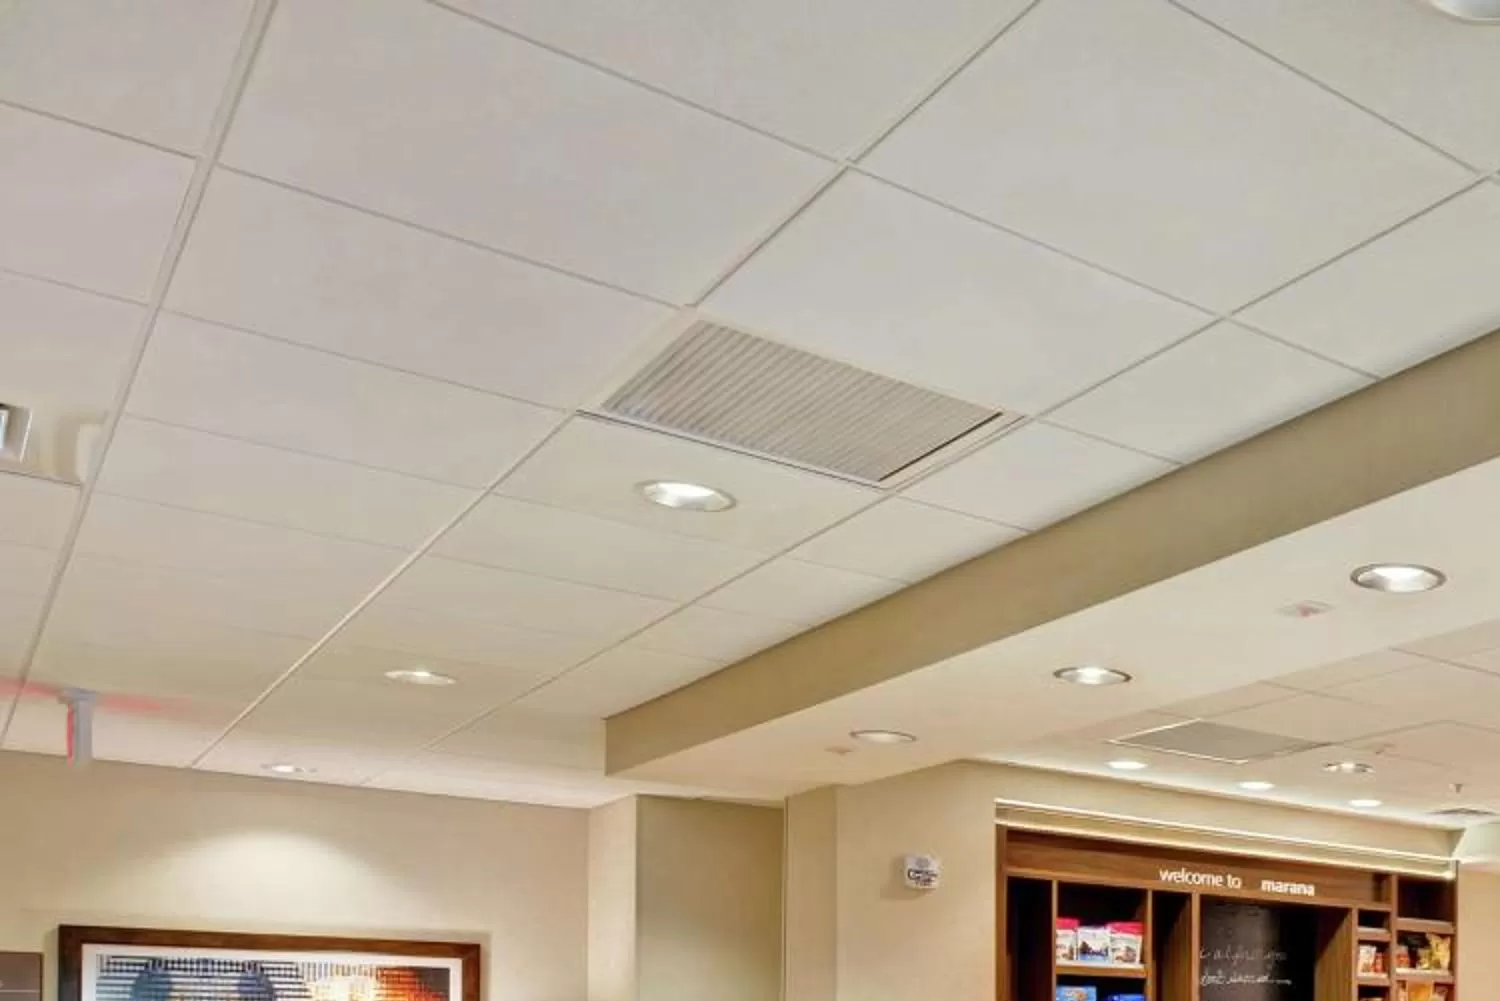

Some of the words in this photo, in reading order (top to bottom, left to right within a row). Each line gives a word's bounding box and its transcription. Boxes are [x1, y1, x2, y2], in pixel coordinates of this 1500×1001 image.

[1159, 867, 1223, 887] welcome
[1227, 874, 1242, 889] to
[1260, 879, 1315, 896] marana
